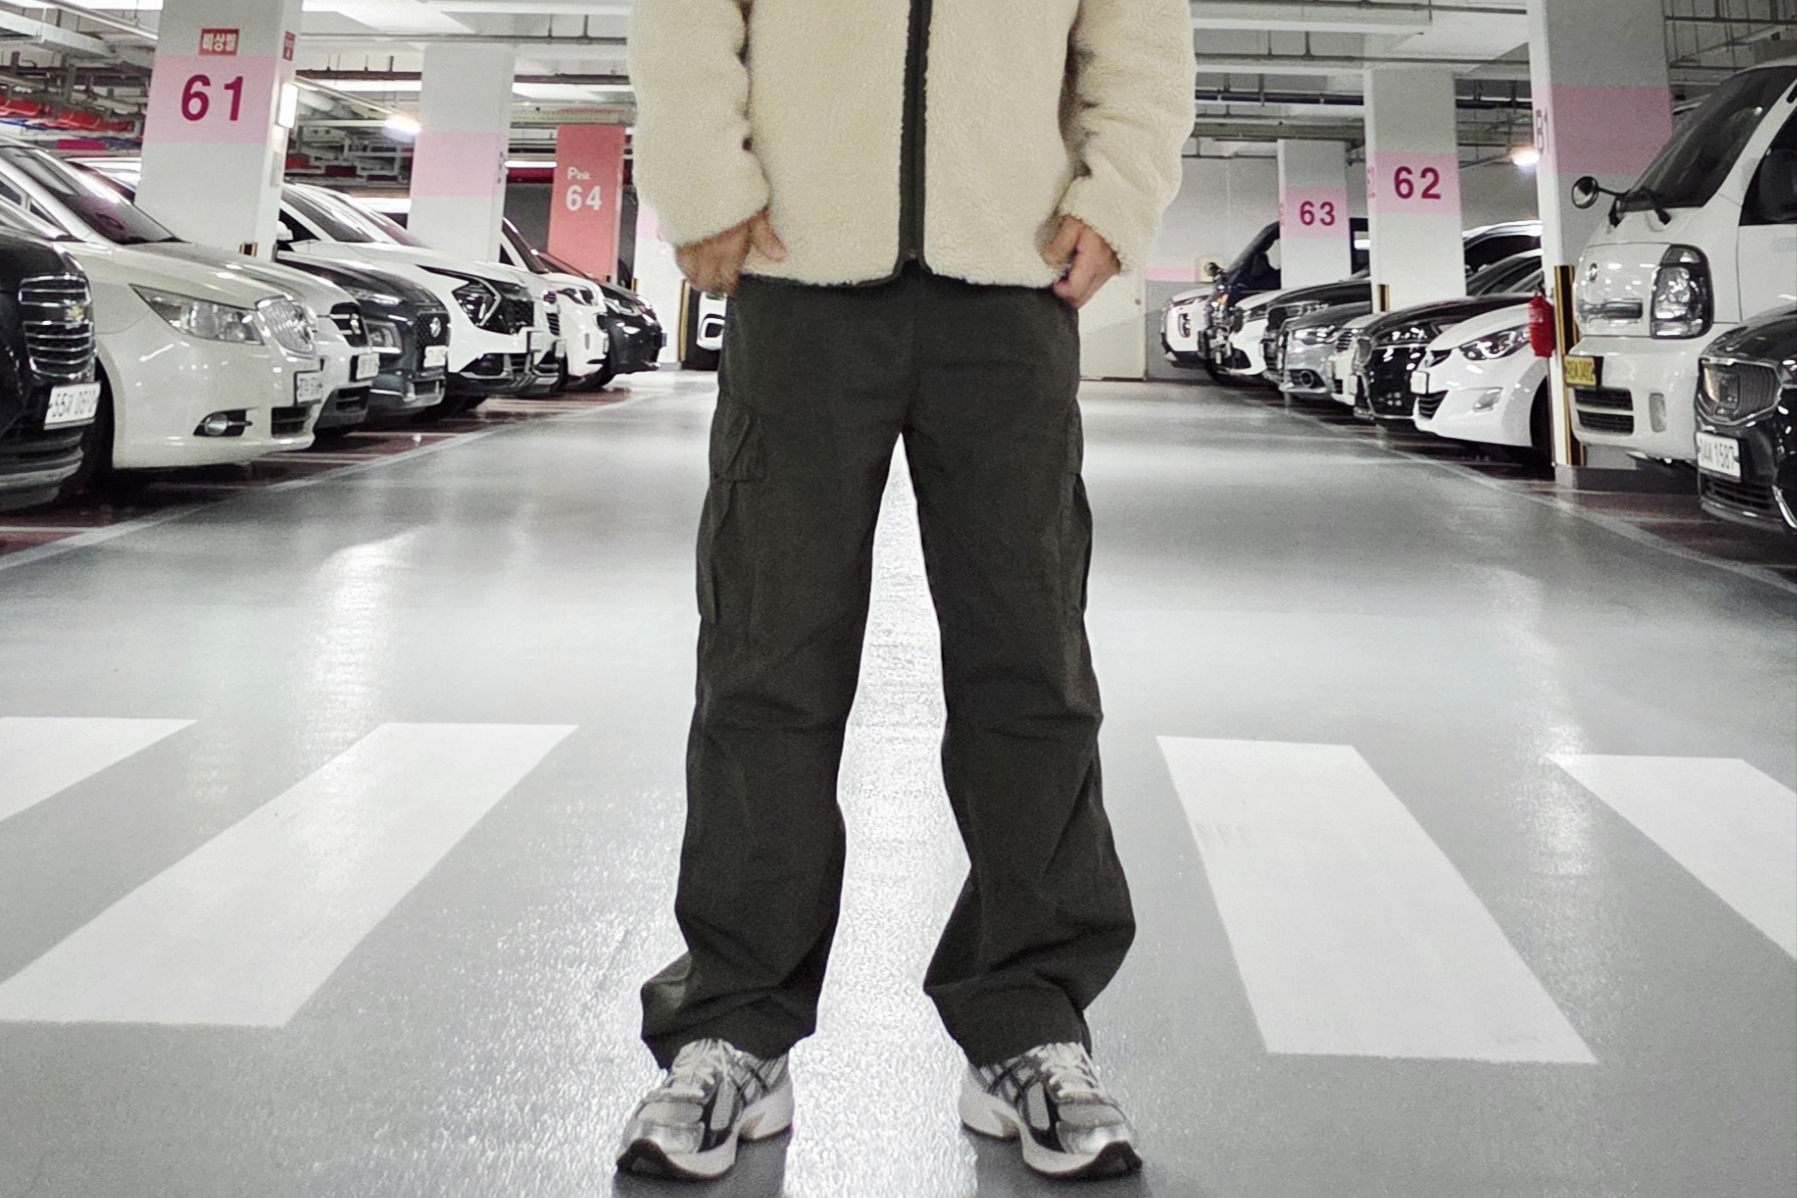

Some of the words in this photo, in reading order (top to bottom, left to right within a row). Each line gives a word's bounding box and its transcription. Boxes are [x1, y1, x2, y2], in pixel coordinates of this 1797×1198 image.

[181, 74, 243, 121] 61
[565, 184, 603, 212] 64
[1393, 166, 1442, 200] 62
[1300, 200, 1336, 227] 63
